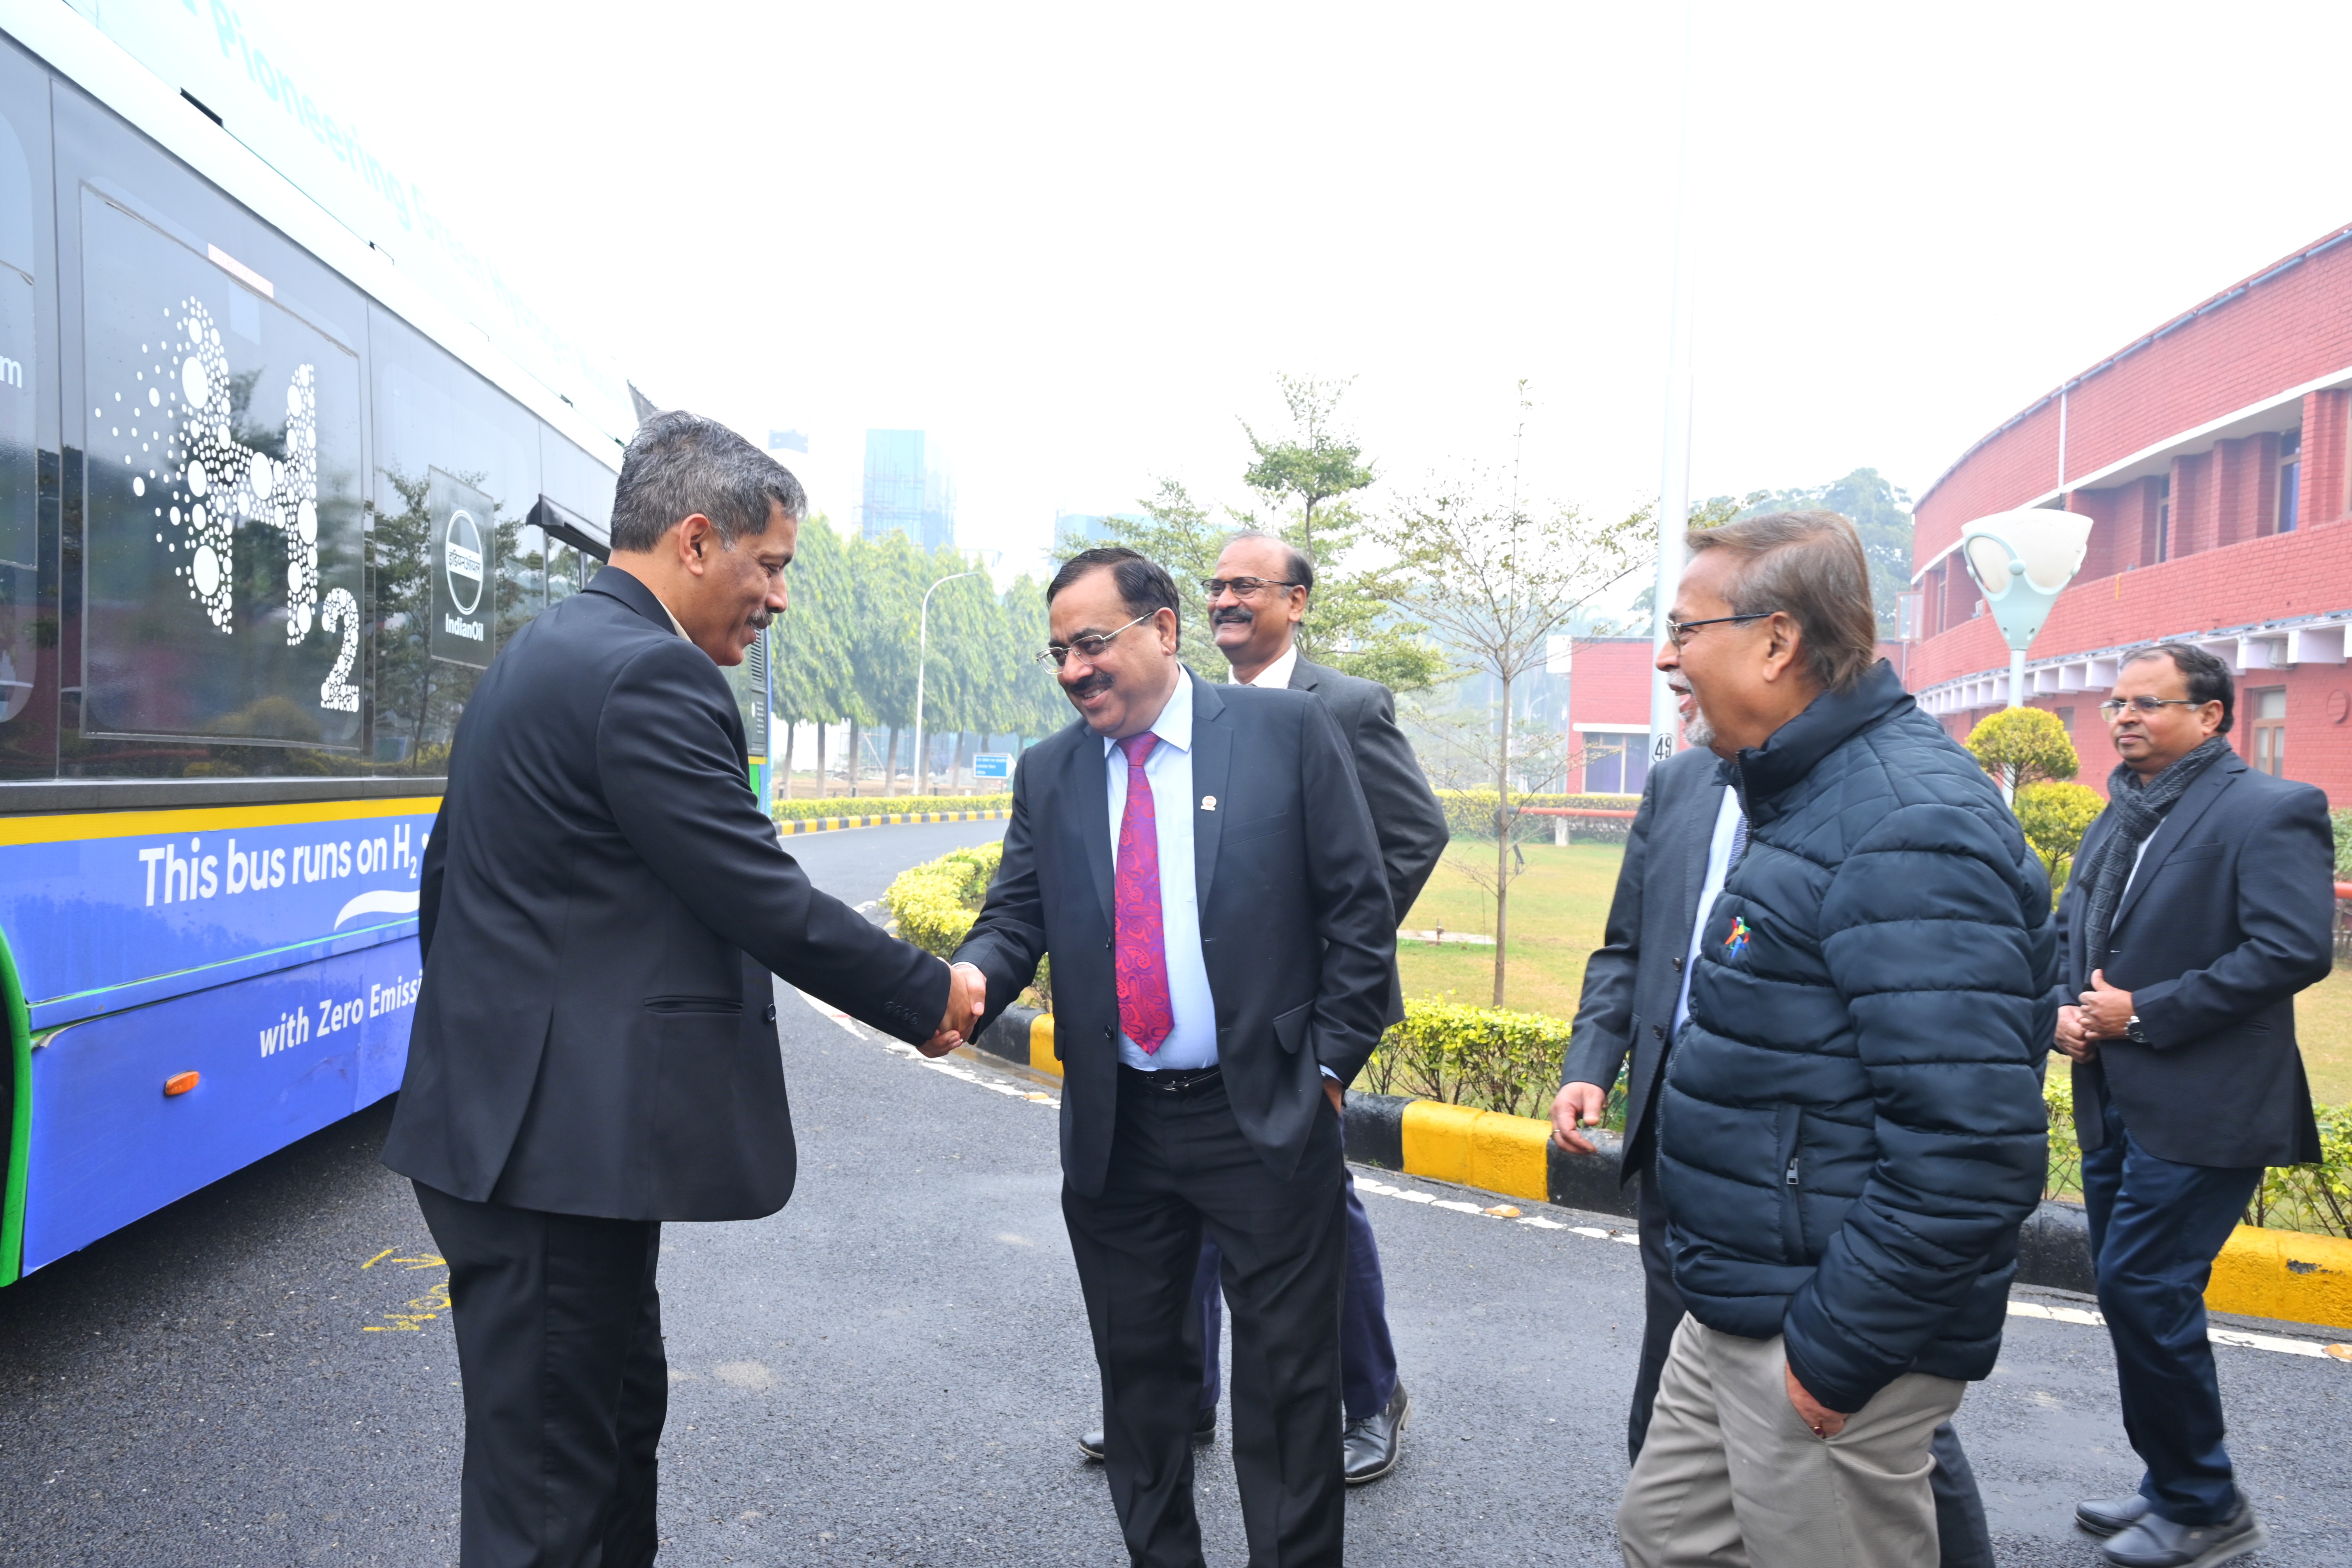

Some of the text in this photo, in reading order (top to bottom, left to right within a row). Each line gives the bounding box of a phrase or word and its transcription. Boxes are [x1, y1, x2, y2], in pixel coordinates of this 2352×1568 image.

[209, 0, 411, 232] Pioneering
[411, 182, 488, 291] Green
[448, 548, 480, 575] इंडियनऑयल
[445, 613, 484, 642] IndianOil
[1655, 736, 1672, 760] 49
[139, 837, 218, 907] This
[226, 838, 286, 894] bus
[292, 841, 352, 885] runs
[357, 837, 387, 874] on
[260, 1006, 309, 1058] with
[317, 998, 364, 1037] Zero
